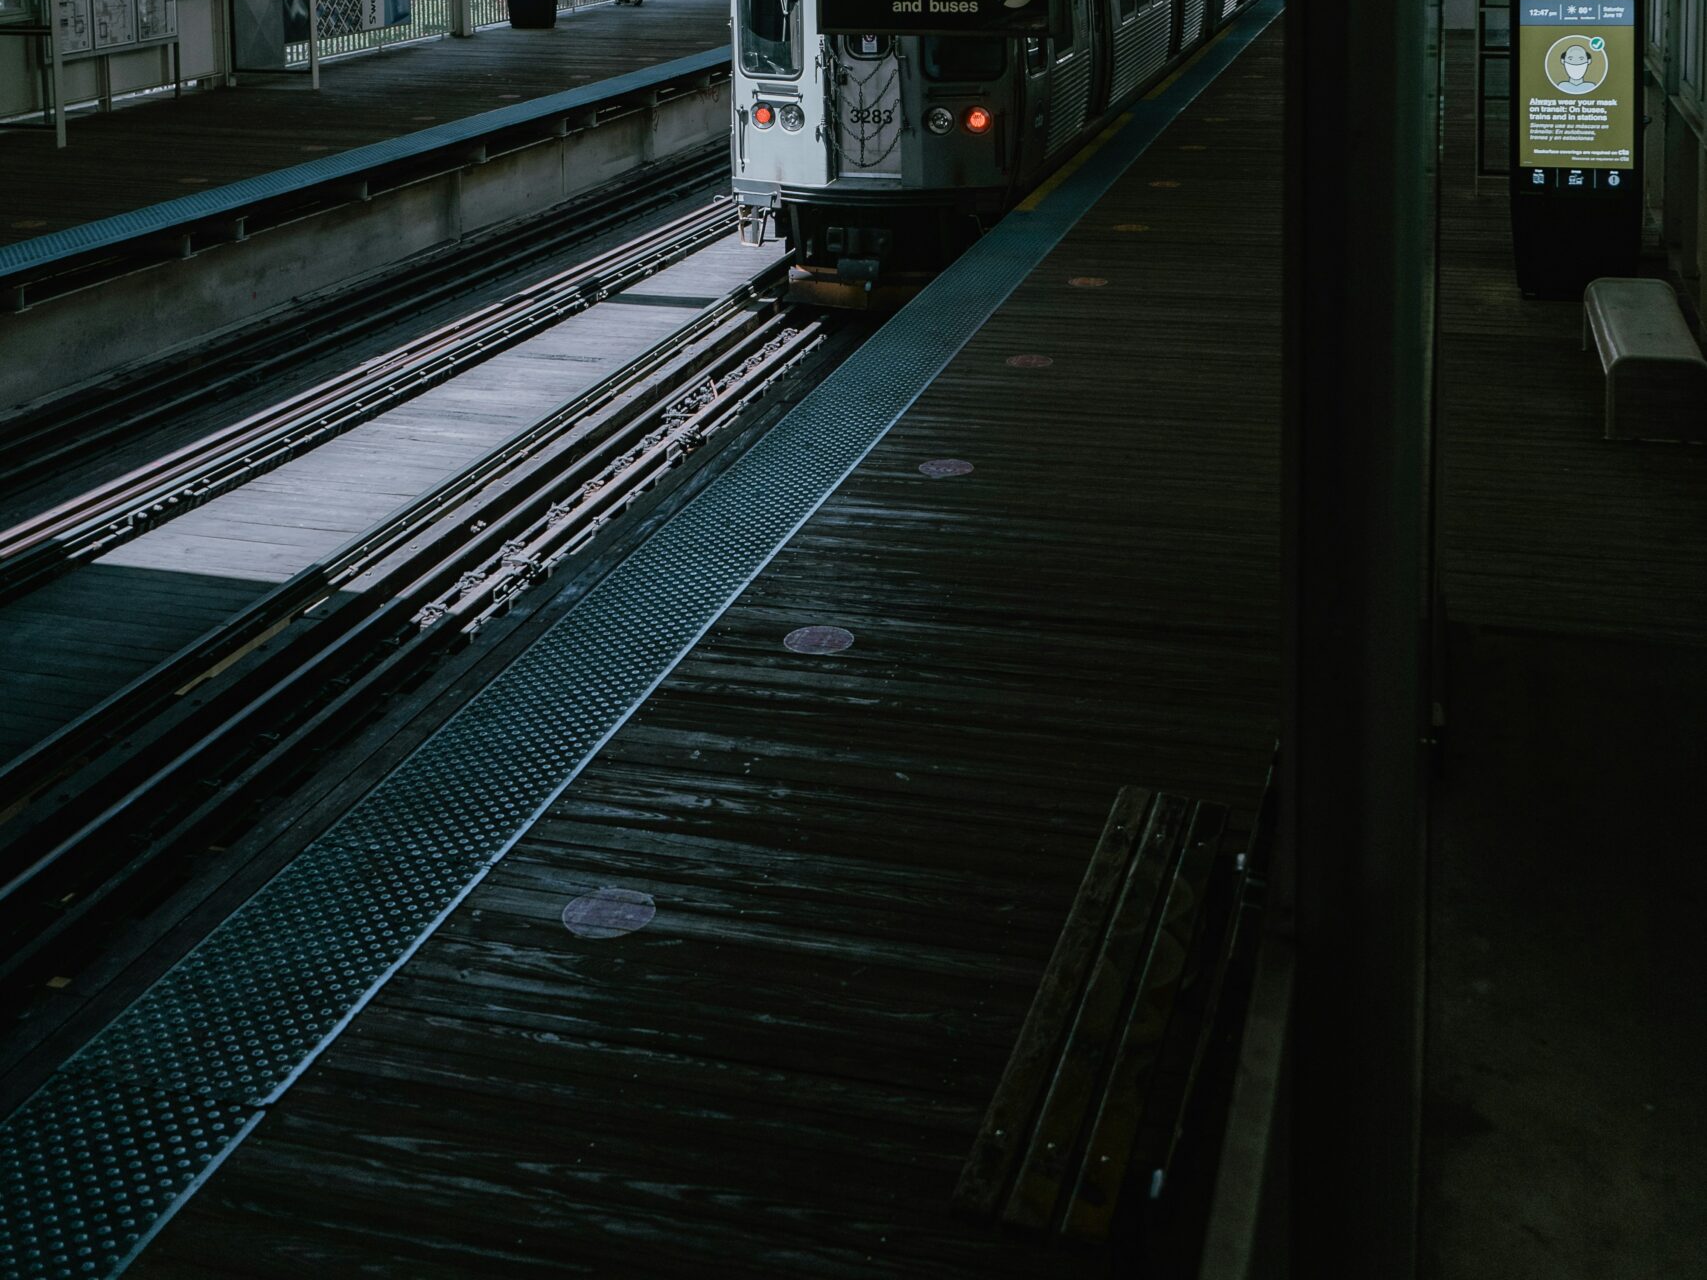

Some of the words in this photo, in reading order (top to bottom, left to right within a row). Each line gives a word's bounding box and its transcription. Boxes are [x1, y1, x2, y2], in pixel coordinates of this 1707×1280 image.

[1529, 9, 1549, 17] 12:47
[1529, 98, 1557, 106] Always
[1578, 99, 1596, 107] your
[1581, 106, 1607, 114] buses,
[850, 109, 893, 123] 3283
